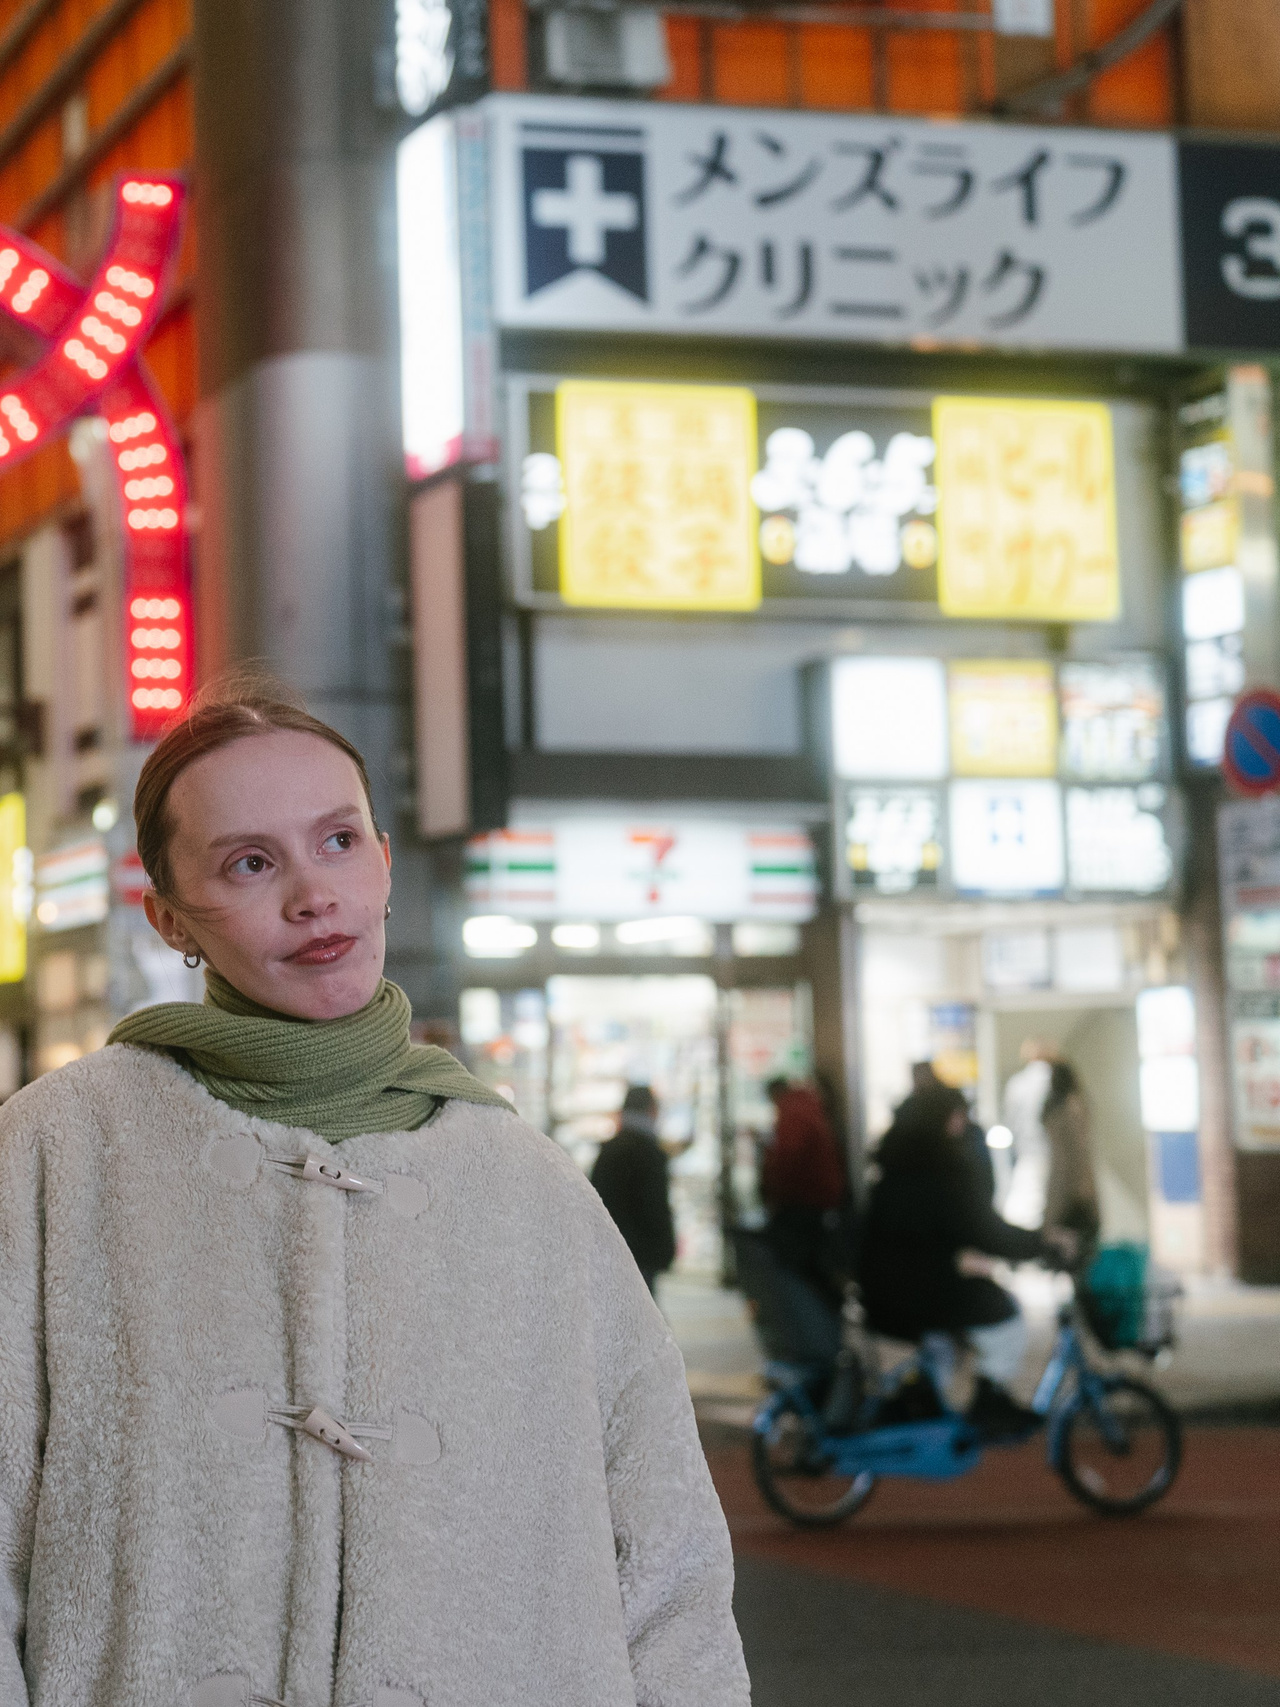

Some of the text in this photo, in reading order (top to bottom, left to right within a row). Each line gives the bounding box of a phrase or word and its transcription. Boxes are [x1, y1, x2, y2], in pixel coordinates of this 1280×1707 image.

[673, 128, 1127, 226] メンズライフ
[675, 233, 1046, 330] クリニック
[1222, 197, 1280, 299] 3
